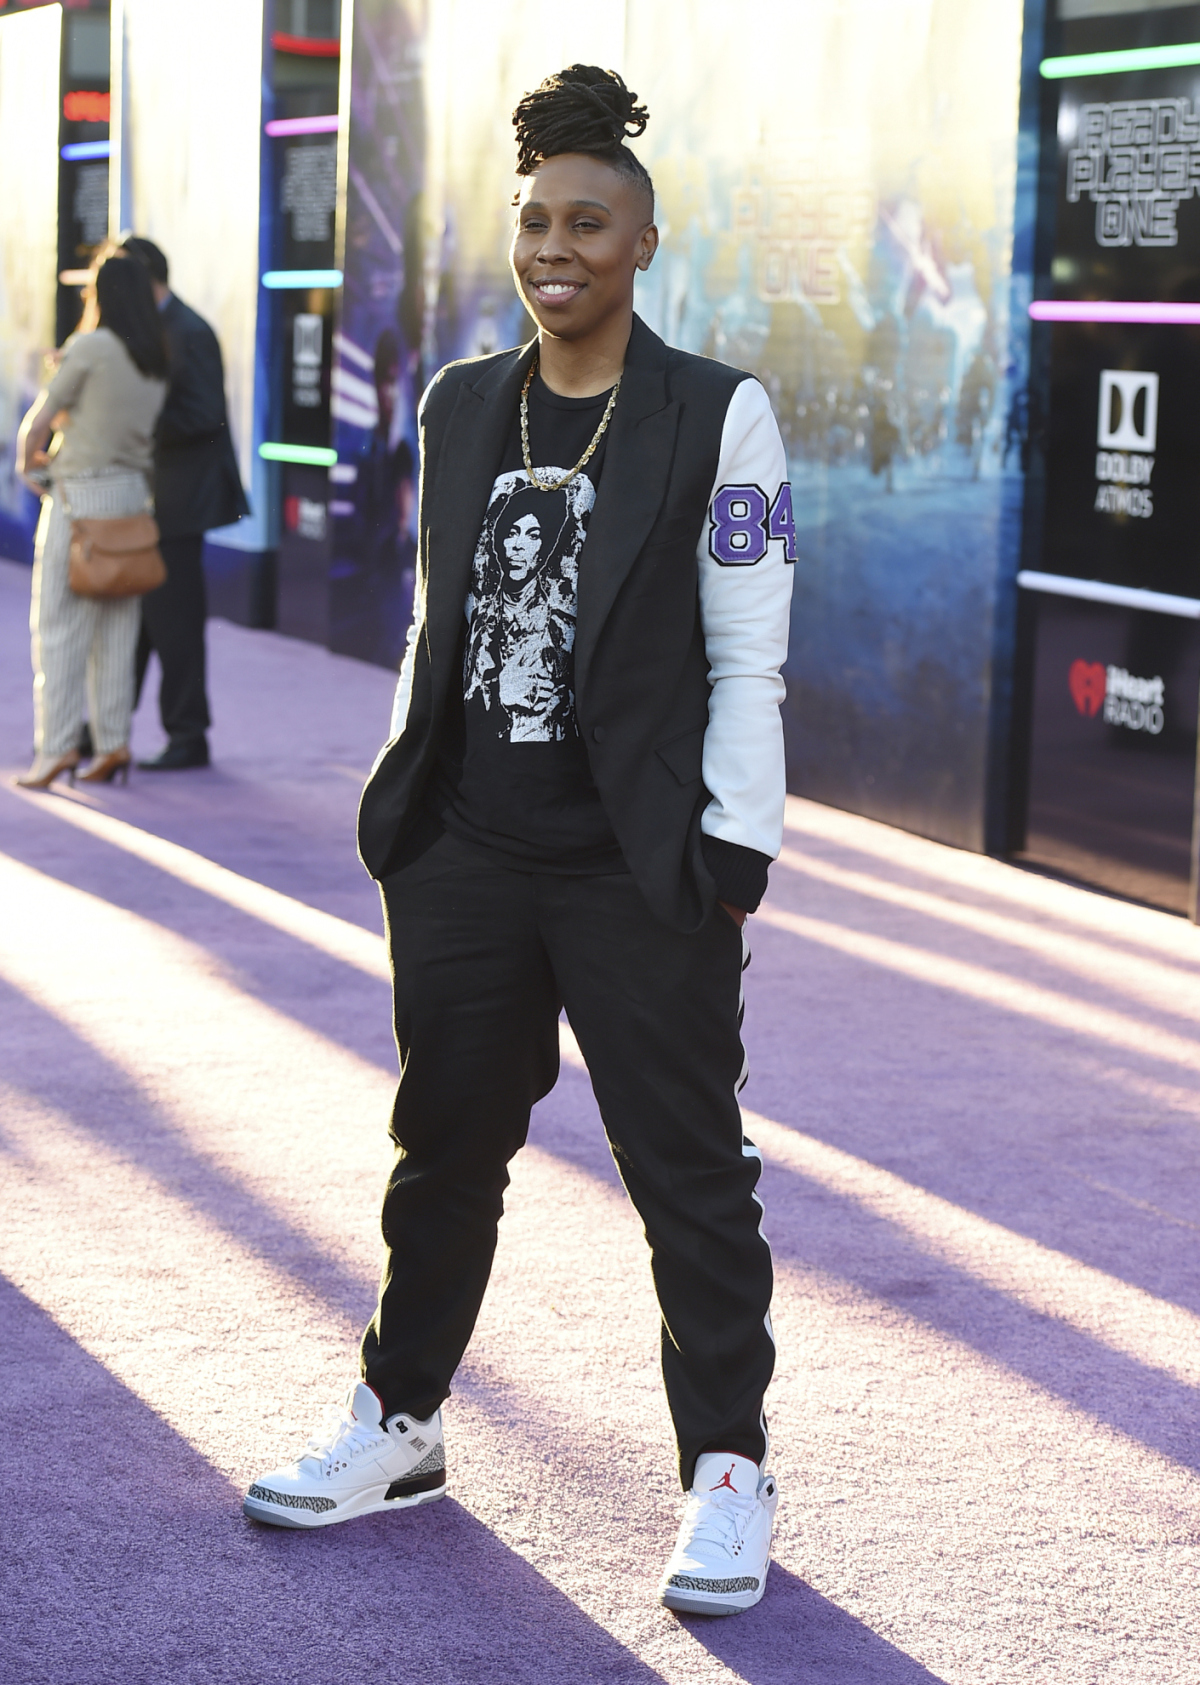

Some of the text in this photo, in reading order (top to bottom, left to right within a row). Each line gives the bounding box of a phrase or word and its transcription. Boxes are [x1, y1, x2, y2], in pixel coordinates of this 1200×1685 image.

[1095, 197, 1179, 247] ONE
[1096, 451, 1154, 485] DOLBY
[1094, 484, 1153, 518] ATMOS
[709, 482, 798, 566] 84
[1103, 695, 1164, 735] RADIO
[408, 1436, 428, 1453] NIKE
